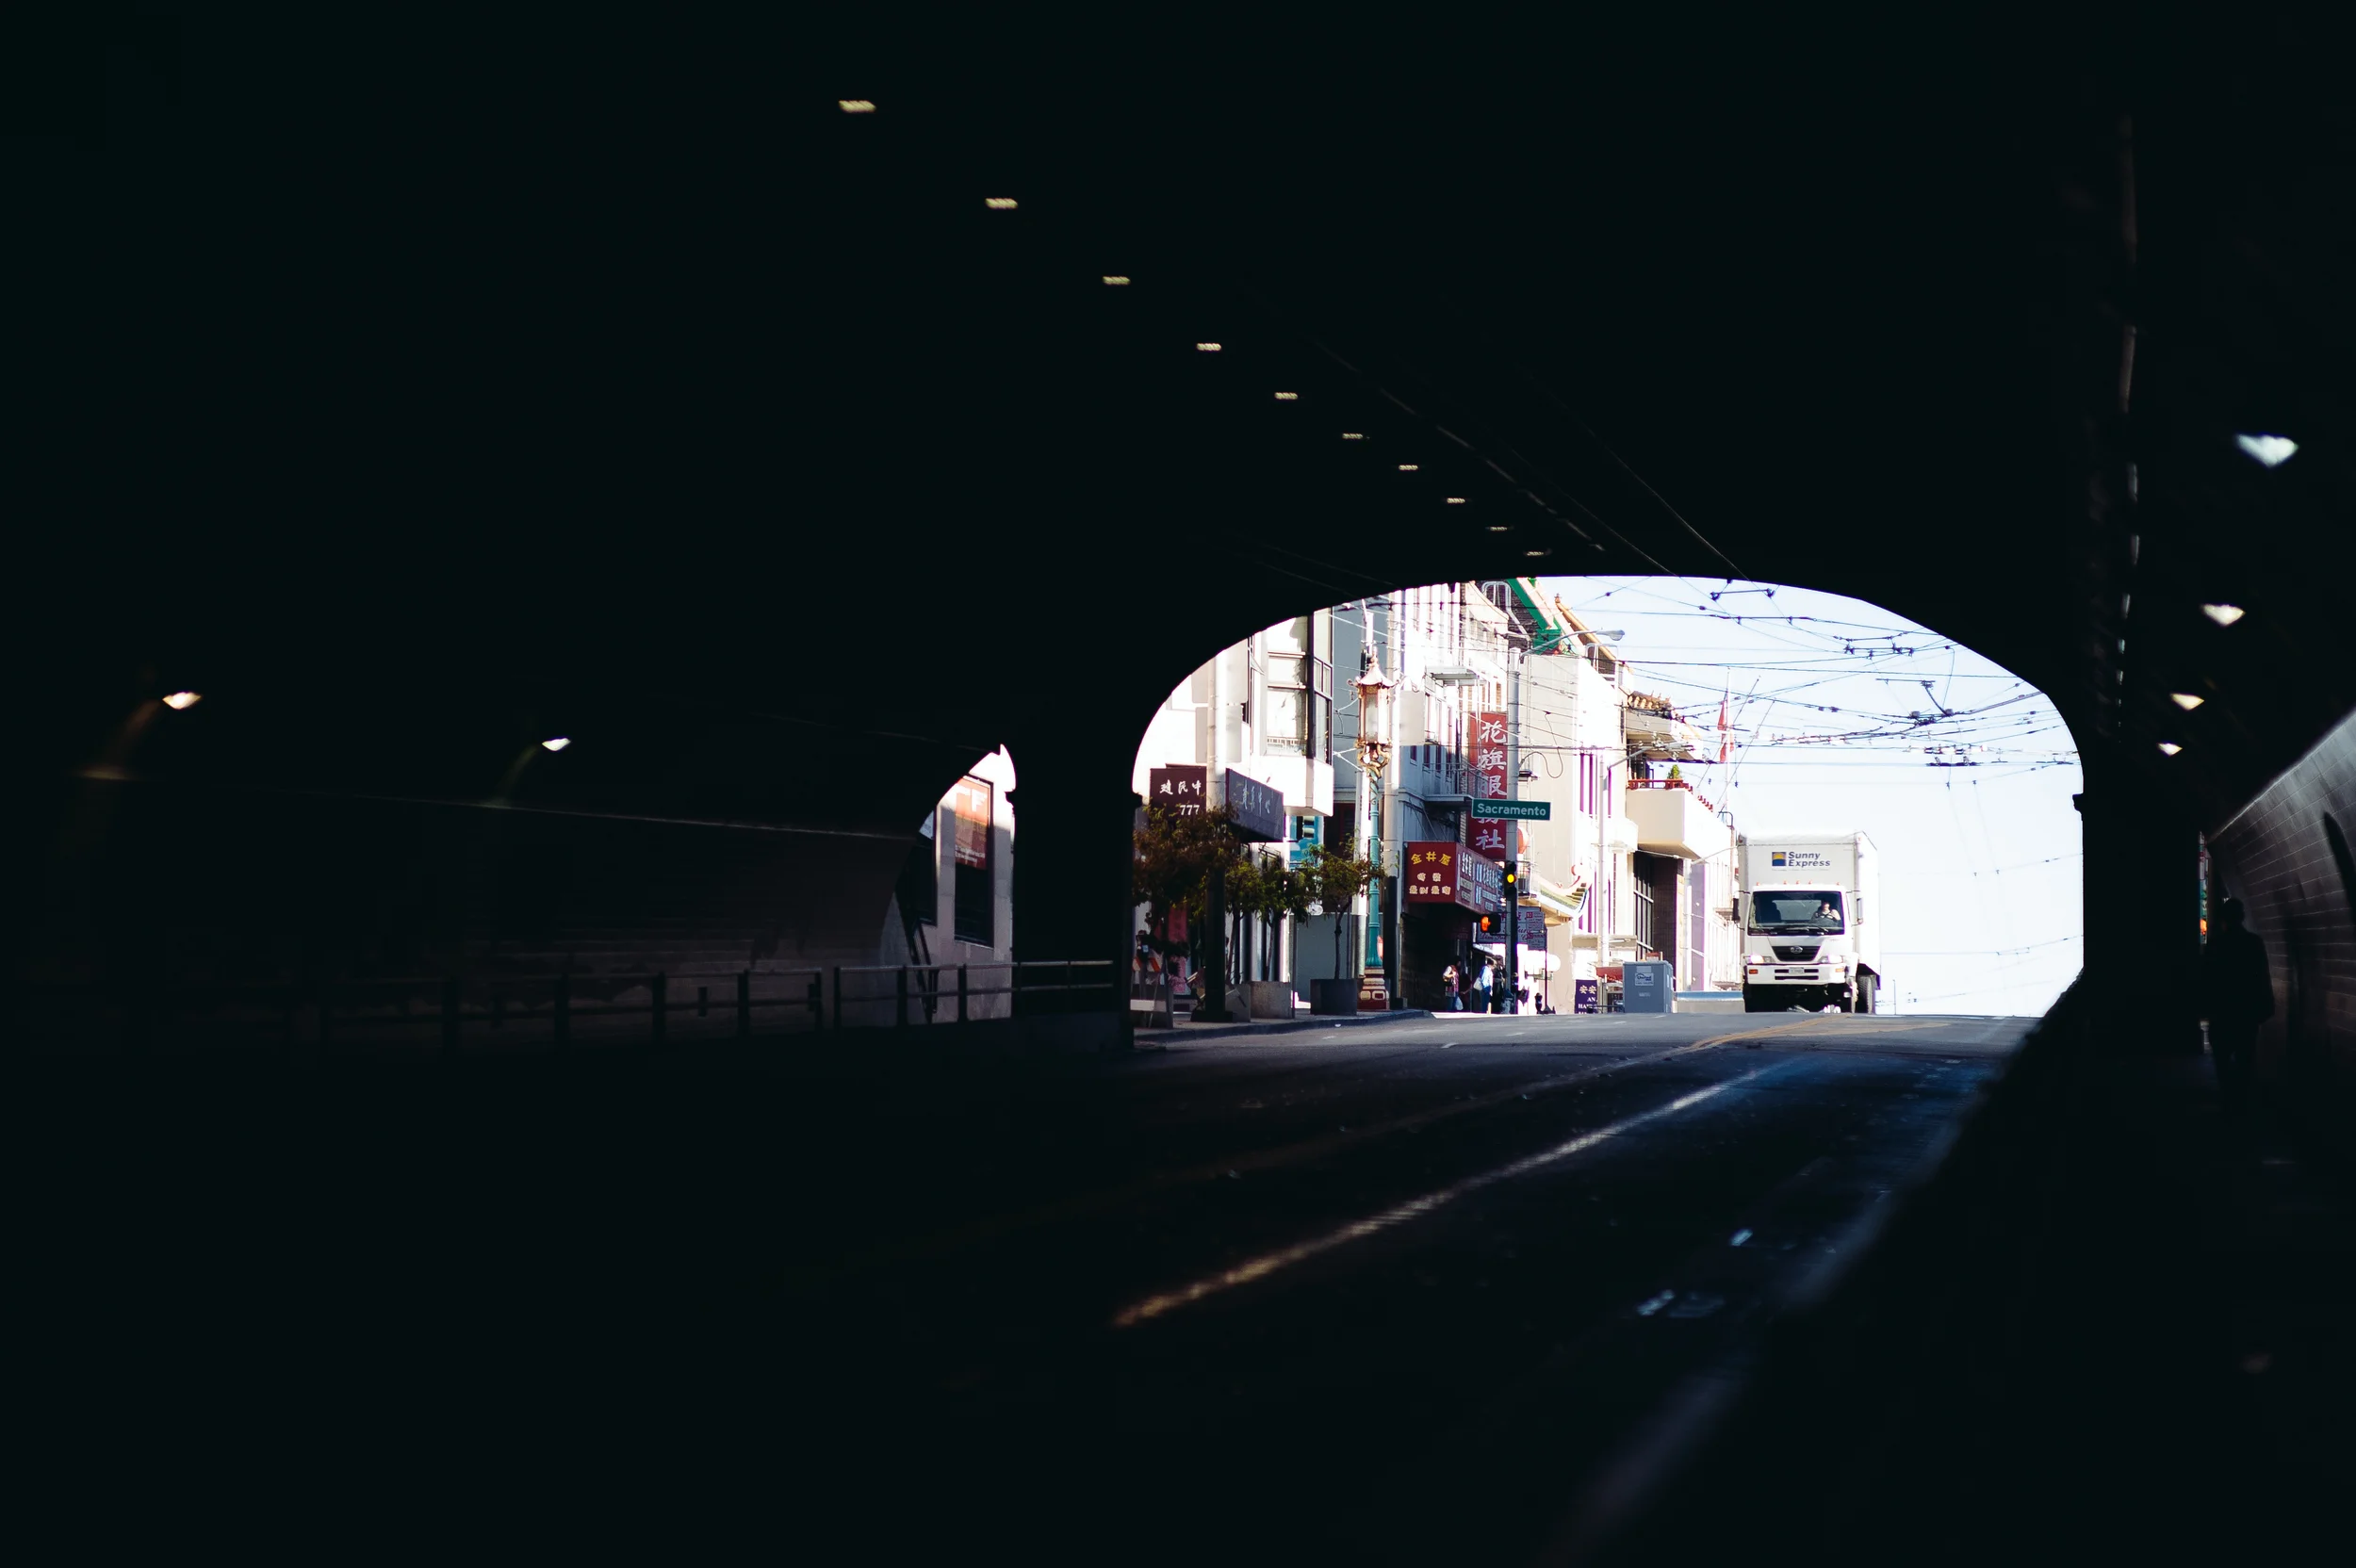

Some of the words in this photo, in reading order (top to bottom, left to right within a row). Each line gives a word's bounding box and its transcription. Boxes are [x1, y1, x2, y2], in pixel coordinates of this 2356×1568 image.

[1180, 804, 1200, 816] 777
[1477, 803, 1546, 816] Sacramento
[1788, 851, 1821, 859] Sunny
[1788, 859, 1831, 868] Express
